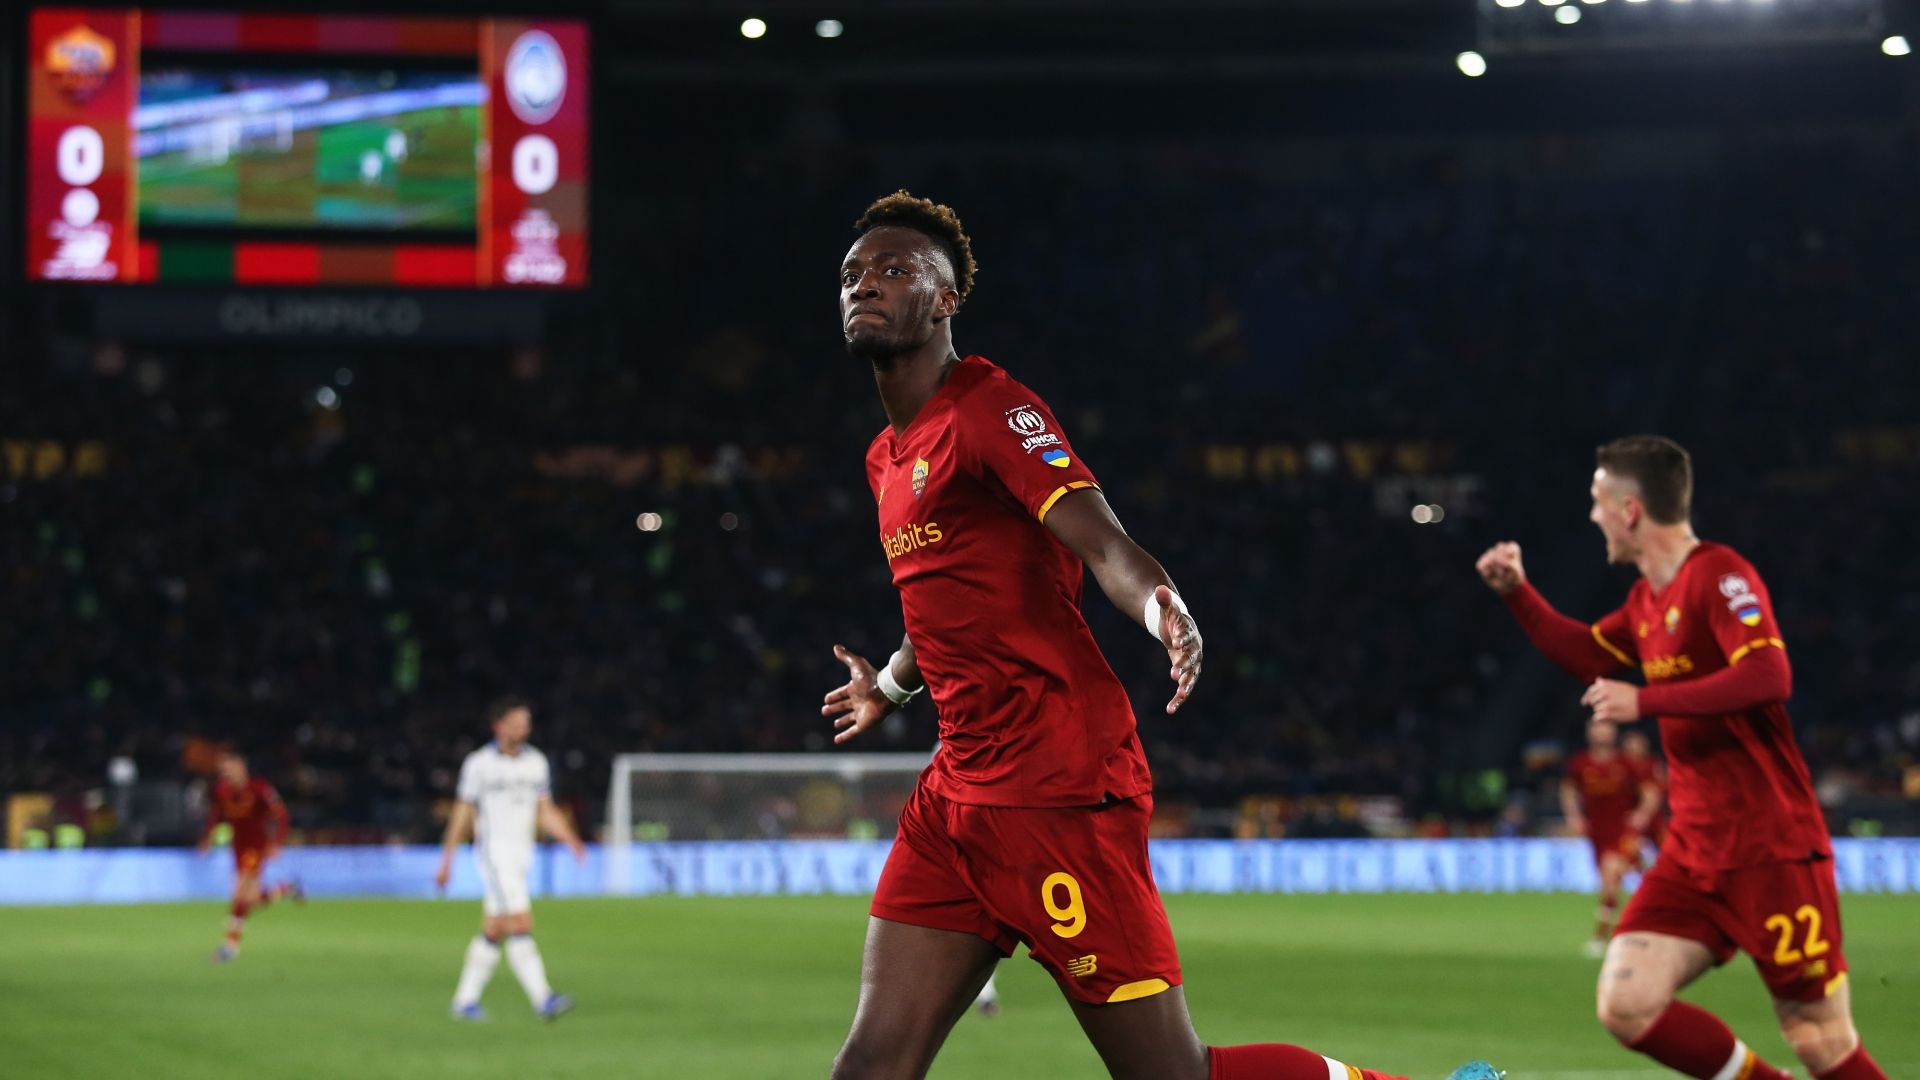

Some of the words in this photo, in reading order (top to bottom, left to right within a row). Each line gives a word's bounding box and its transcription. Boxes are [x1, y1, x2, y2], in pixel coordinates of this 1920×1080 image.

[57, 125, 104, 186] 0
[512, 134, 559, 194] 0
[1022, 433, 1059, 449] UNHCR
[1041, 871, 1087, 938] 9
[1765, 904, 1829, 966] 22
